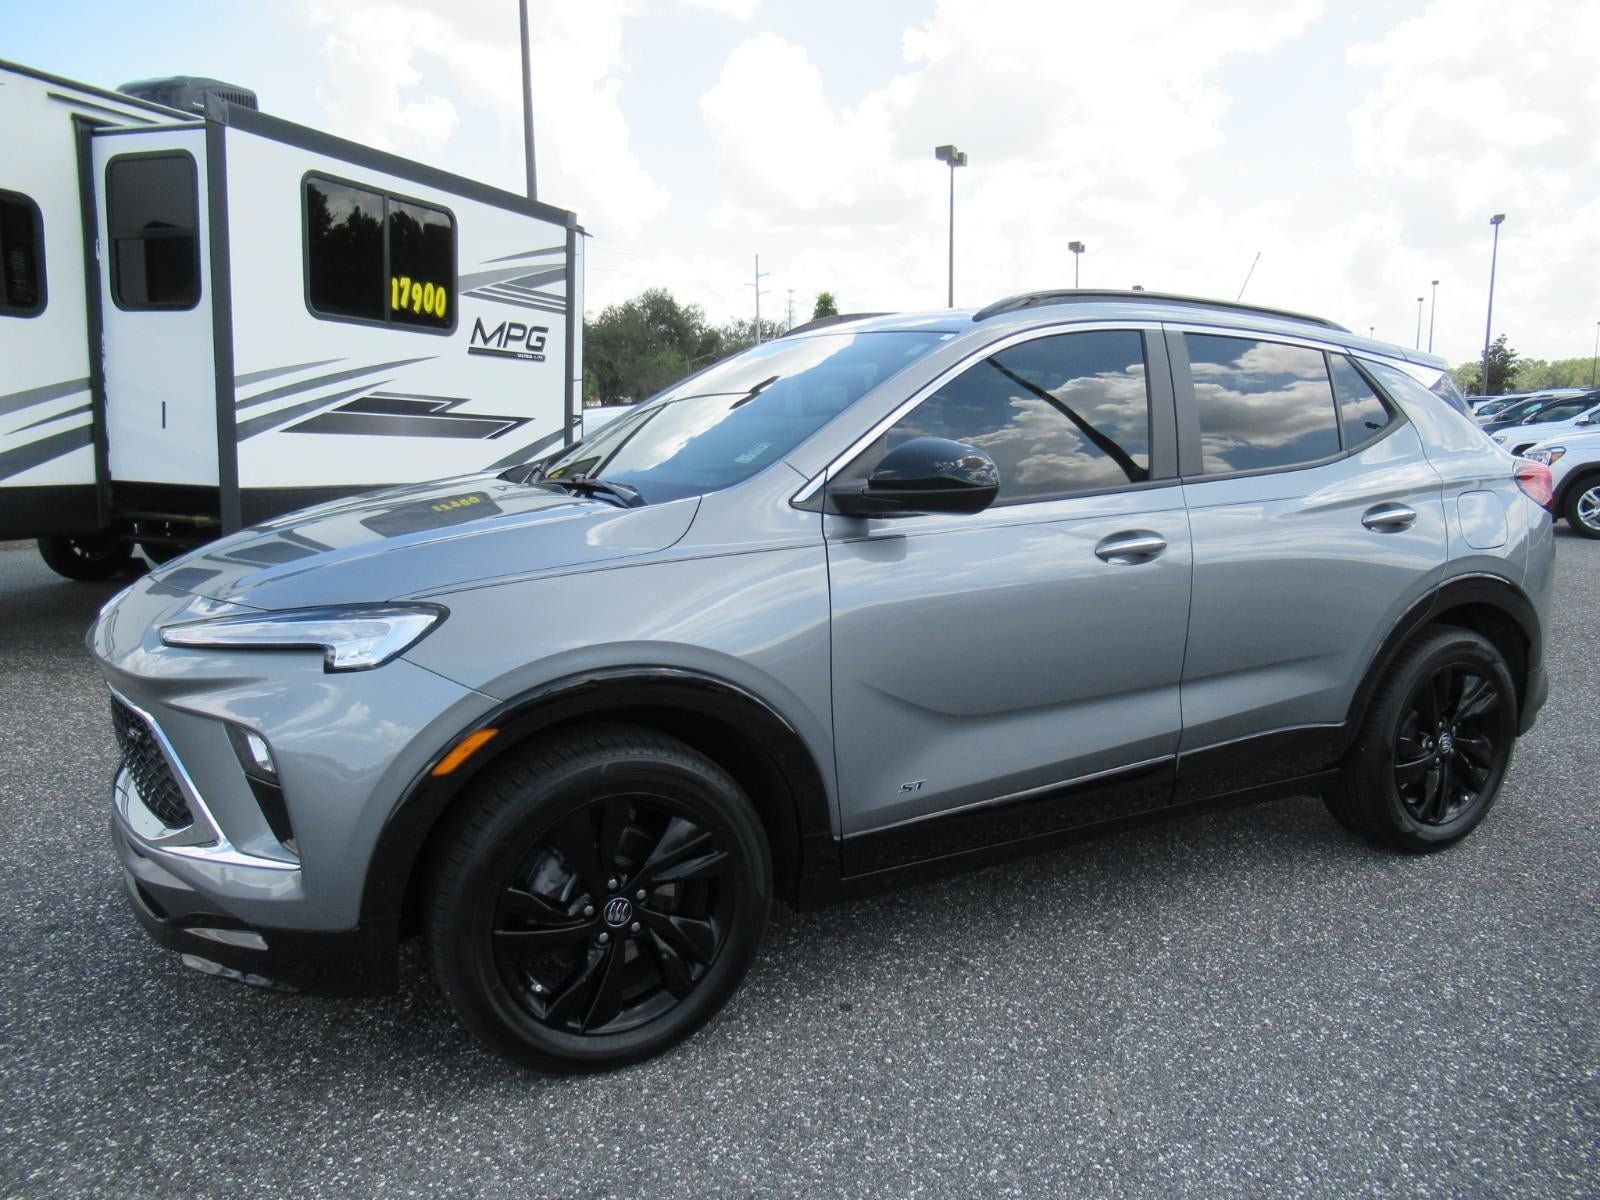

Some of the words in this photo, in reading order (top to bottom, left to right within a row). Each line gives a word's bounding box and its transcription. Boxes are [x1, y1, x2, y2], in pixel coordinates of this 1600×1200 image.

[391, 277, 447, 318] 17900
[470, 317, 549, 352] MPG
[899, 779, 927, 793] ST
